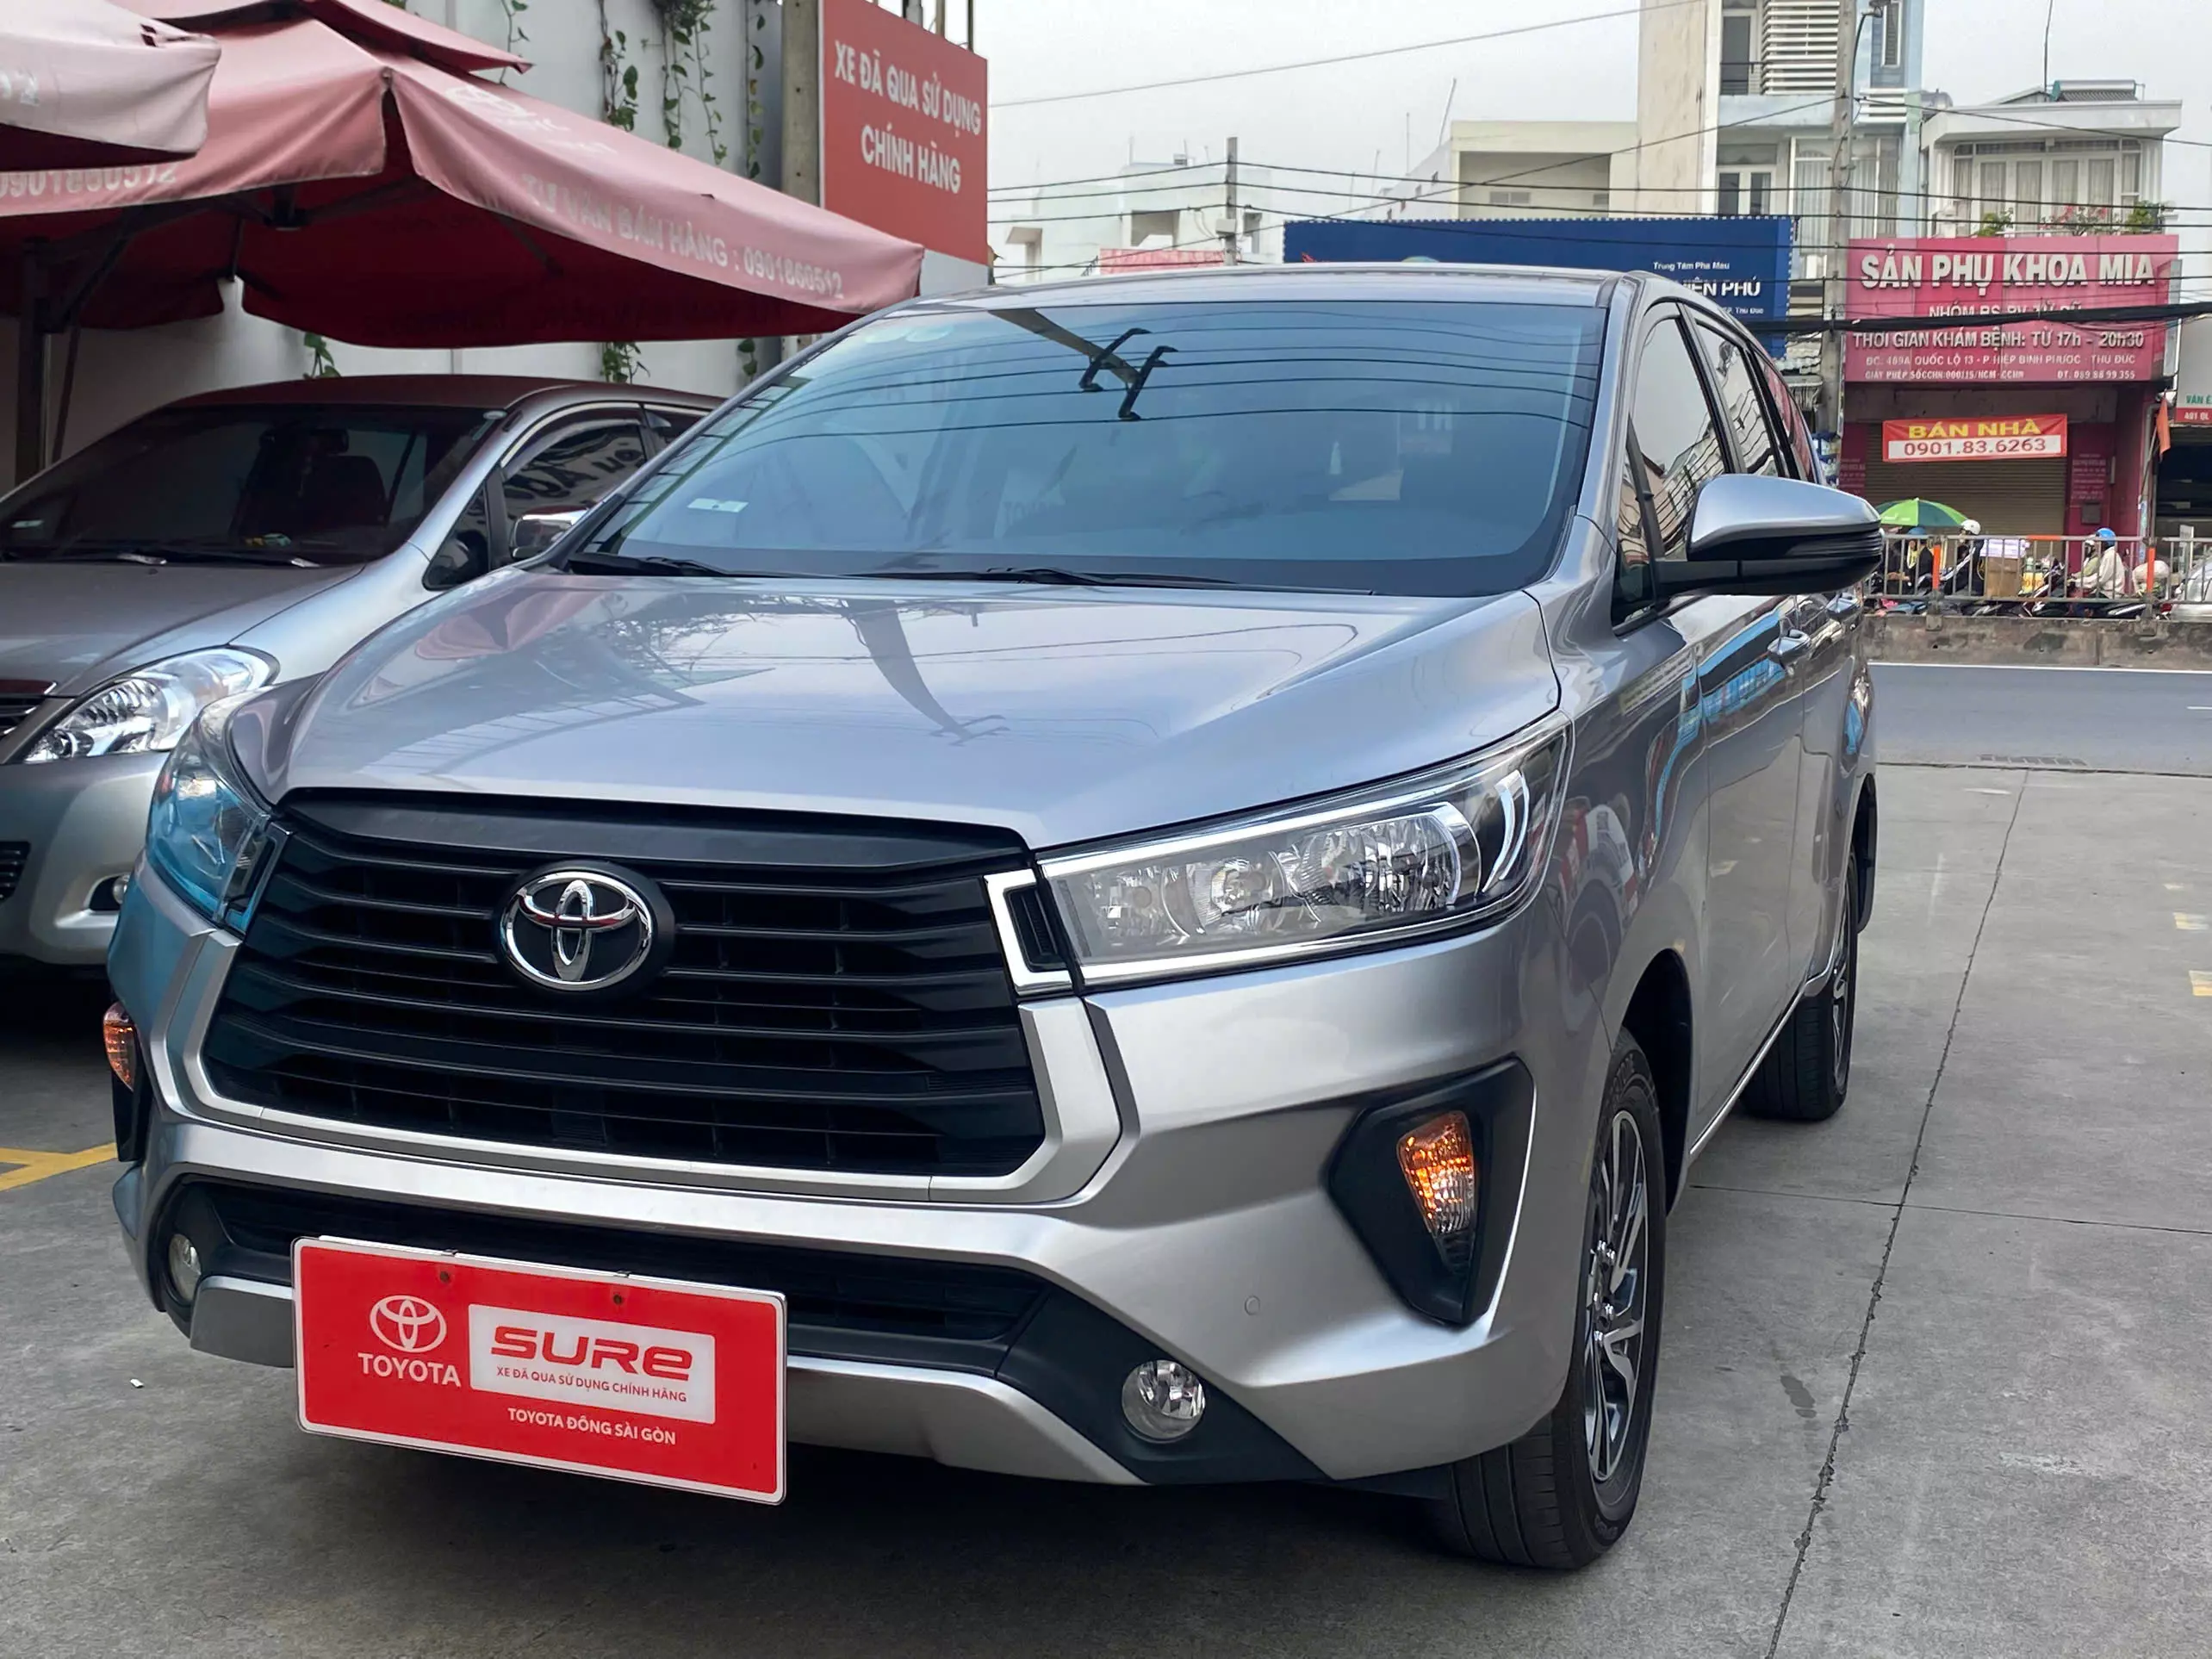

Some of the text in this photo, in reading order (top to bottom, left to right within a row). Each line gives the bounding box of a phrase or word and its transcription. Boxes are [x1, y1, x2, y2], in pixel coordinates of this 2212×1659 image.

[835, 40, 856, 85] XE
[886, 64, 919, 111] QUA
[922, 71, 941, 119] SỬ
[943, 89, 982, 138] DỤNG
[861, 122, 914, 178] CHÍNH
[668, 221, 728, 268] HÀNG
[1653, 261, 1675, 271] Trung
[1861, 243, 2155, 296] SẢN PHỤ KHOA MIA
[1721, 276, 1761, 296] PHÚ
[1929, 299, 1976, 317] NHÓM
[1892, 331, 1930, 348] GIAN
[1932, 326, 1978, 348] KHÁM
[1980, 326, 2026, 351] BỆNH:
[2030, 325, 2054, 348] TỪ
[2057, 331, 2082, 348] 17h
[2098, 331, 2145, 348] 20h30
[1915, 351, 1944, 365] QUỐC
[1948, 352, 1961, 367] LỘ
[1964, 355, 1974, 365] 13
[1908, 418, 2041, 439] BÁN NHÀ
[1903, 438, 2047, 457] 0901.83.6263
[358, 1351, 462, 1388] TOYOTA
[497, 1366, 510, 1377] XE
[513, 1368, 528, 1380] ĐÃ
[531, 1371, 556, 1383] QUA
[576, 1377, 610, 1392] DỤNG
[612, 1382, 649, 1397] CHÍNH
[507, 1407, 676, 1445] TOYOTA ĐÔNG SÀI GÒN
